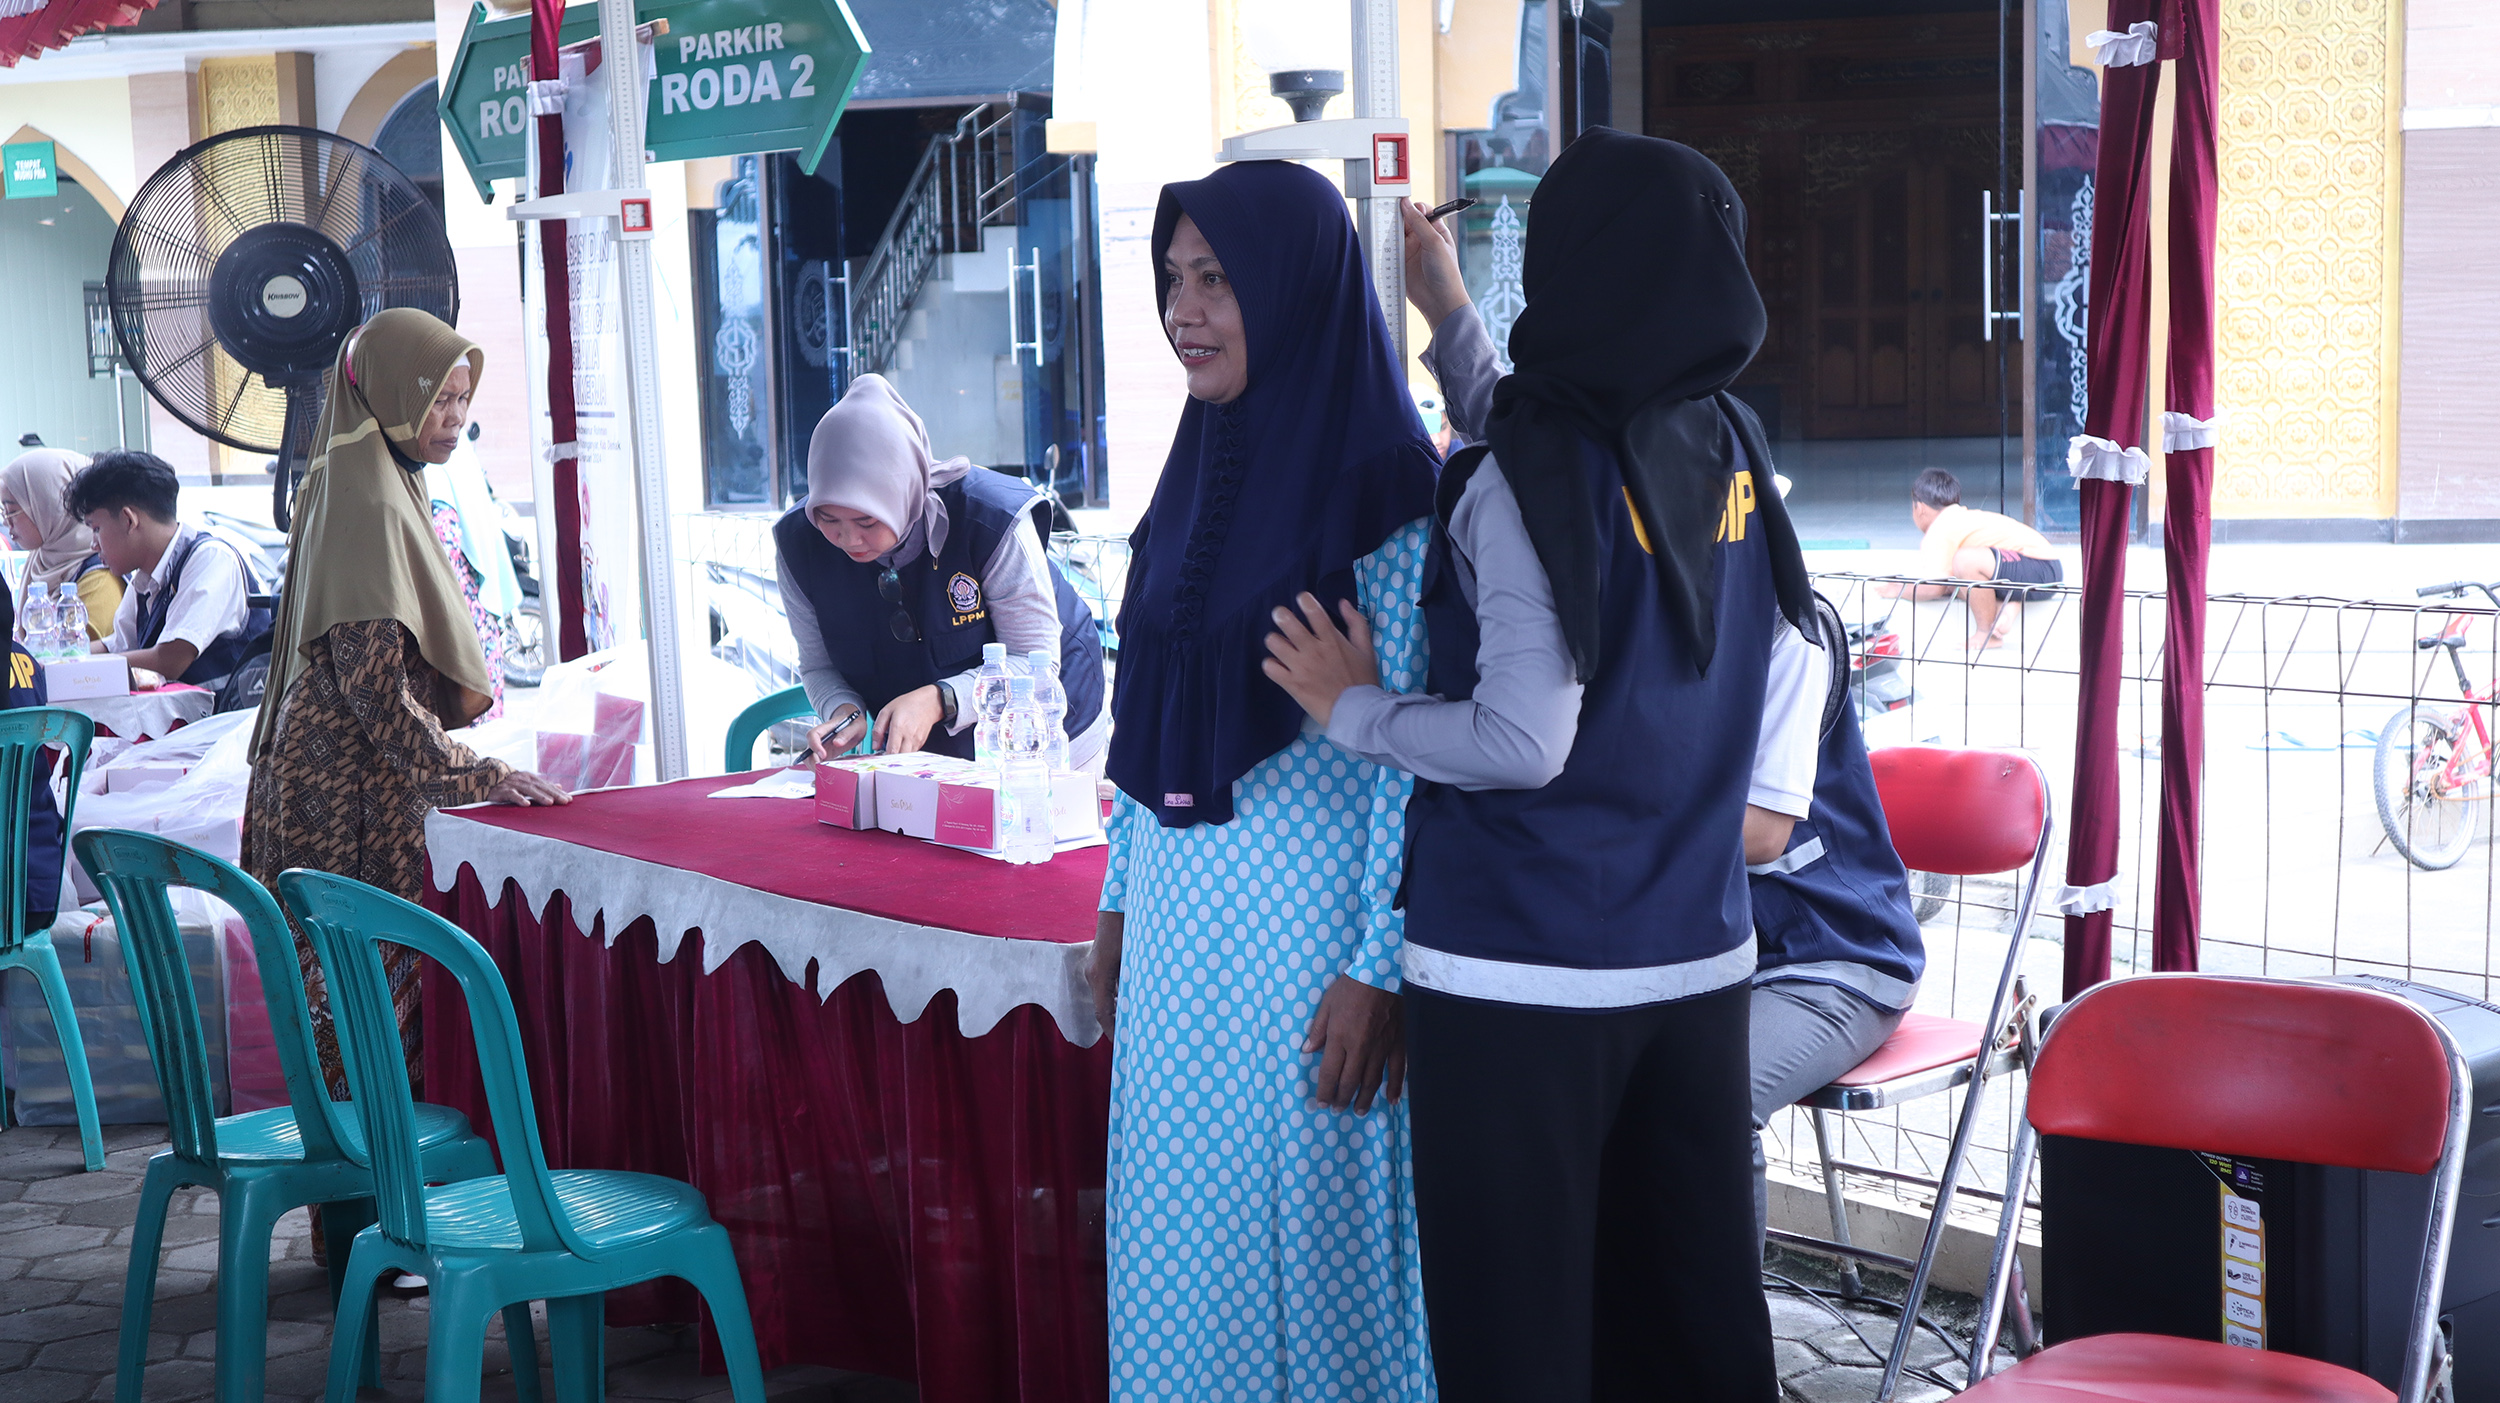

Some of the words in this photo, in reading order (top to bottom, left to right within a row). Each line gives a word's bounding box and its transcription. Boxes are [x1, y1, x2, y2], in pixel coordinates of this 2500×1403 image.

[679, 22, 785, 64] PARKIR
[661, 59, 782, 115] RODA
[789, 53, 815, 98] 2
[15, 158, 42, 170] TEMPAT
[951, 610, 985, 626] LPPM
[2201, 1151, 2216, 1159] POWER
[2216, 1155, 2232, 1163] OUTPUT
[2219, 1160, 2232, 1169] Watt
[2220, 1167, 2232, 1175] RMS
[2236, 1306, 2256, 1317] OPTICAL
